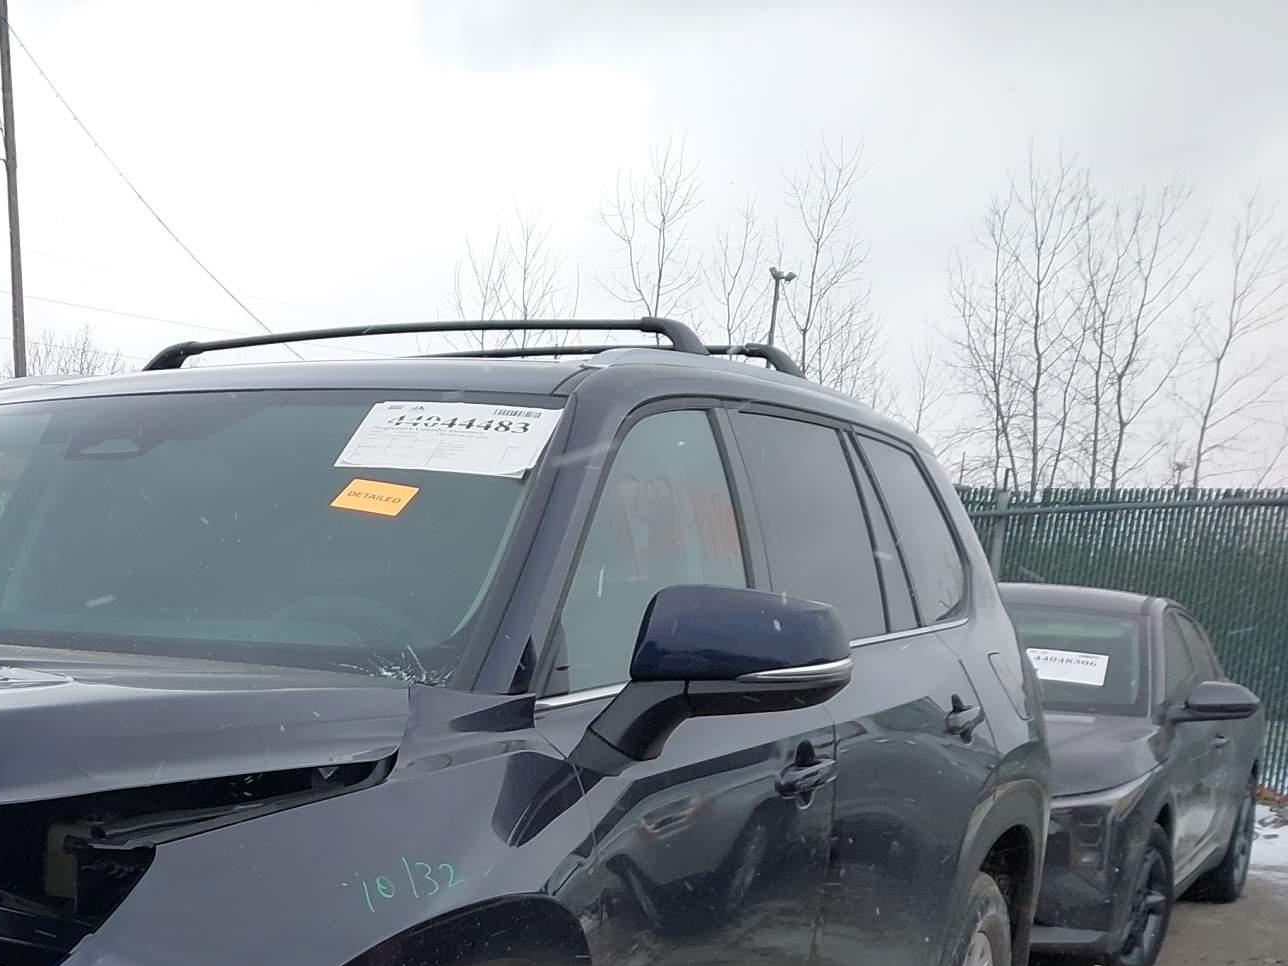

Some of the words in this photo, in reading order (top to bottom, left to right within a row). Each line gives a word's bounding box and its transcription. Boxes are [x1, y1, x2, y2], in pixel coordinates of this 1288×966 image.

[387, 414, 531, 434] 44044483
[347, 490, 403, 504] DETAILED
[362, 856, 468, 913] 10/32
